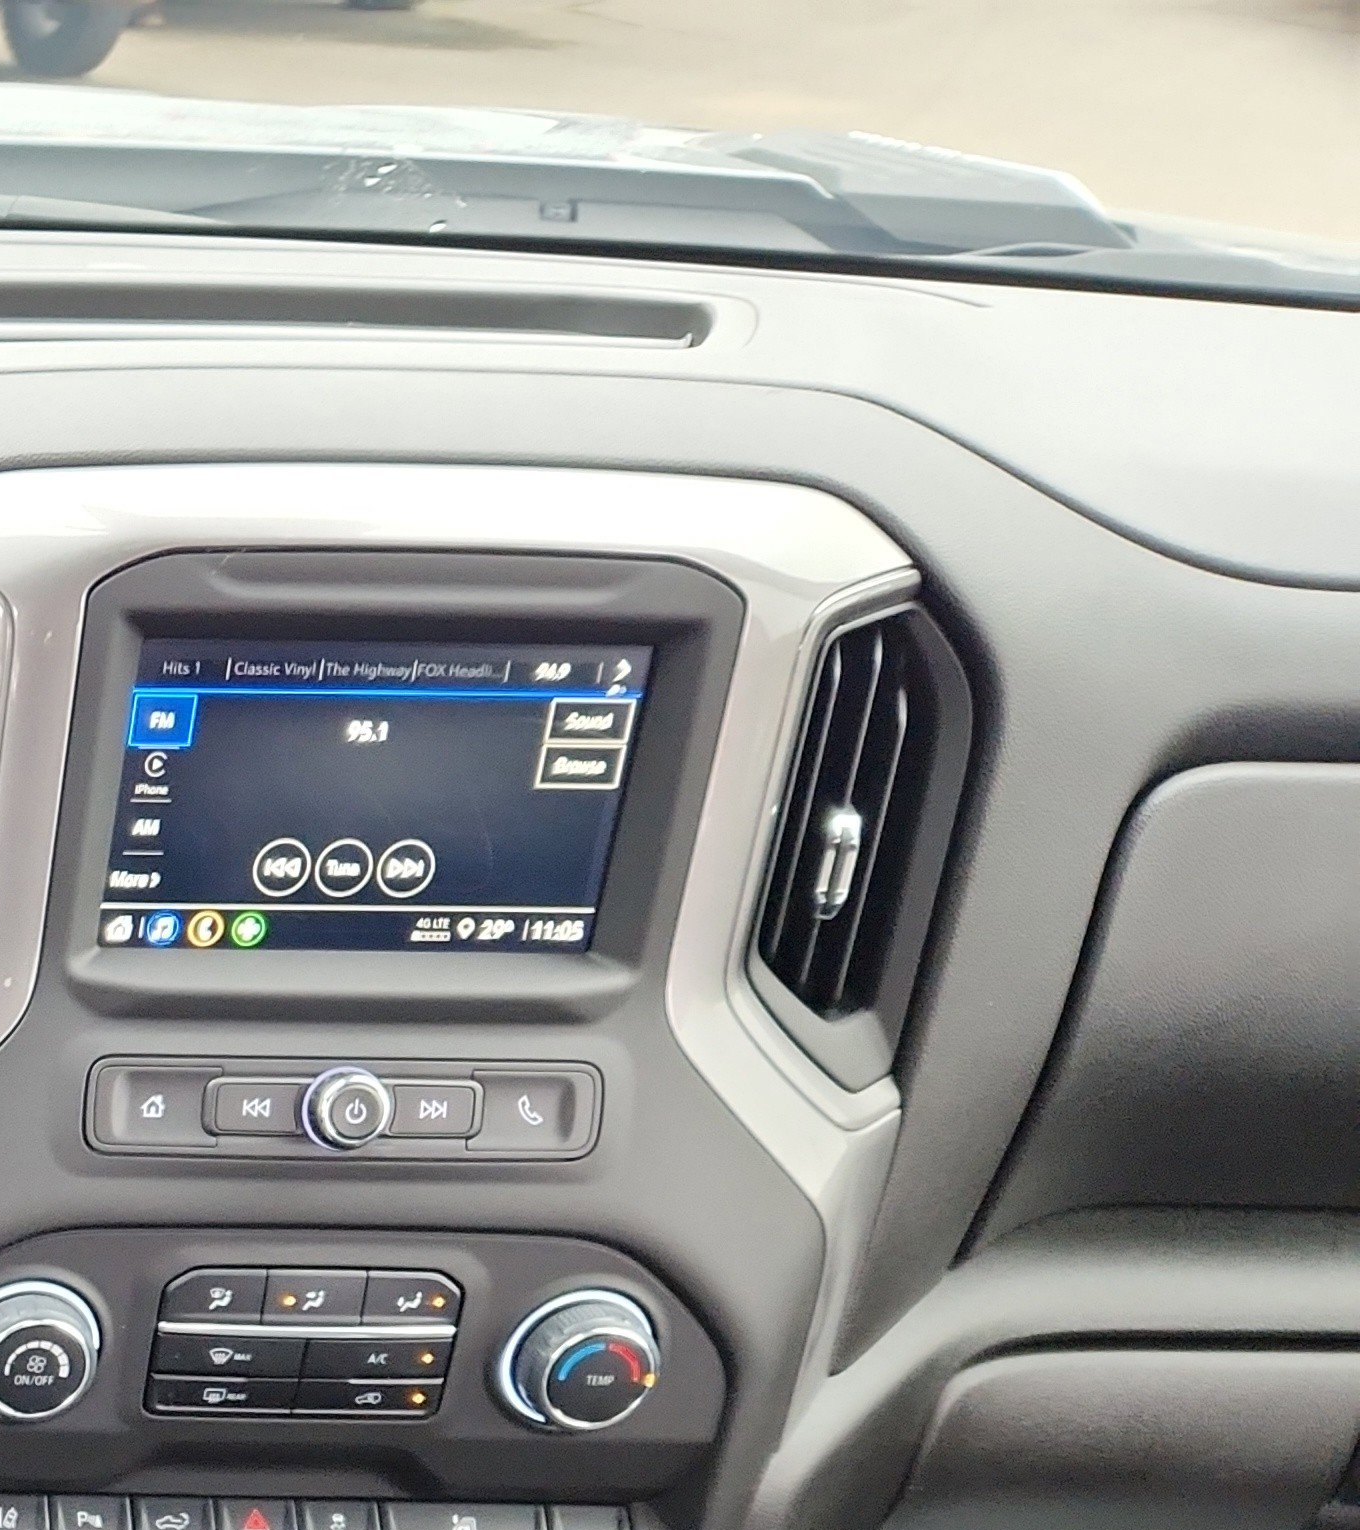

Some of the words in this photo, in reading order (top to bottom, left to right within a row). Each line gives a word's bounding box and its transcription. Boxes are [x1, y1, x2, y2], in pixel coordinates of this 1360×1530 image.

[163, 660, 191, 675] Hits
[233, 661, 281, 677] Classic
[284, 660, 317, 680] Vinyl
[327, 662, 351, 677] The
[353, 662, 412, 681] Highway
[417, 662, 447, 677] FOX
[149, 711, 176, 730] FM
[346, 719, 389, 743] 95.1
[134, 784, 170, 797] iPhone
[131, 818, 161, 837] AM
[109, 870, 150, 889] More
[432, 917, 451, 929] LTE
[530, 919, 585, 942] 11:05
[367, 1353, 389, 1365] A/C
[14, 1374, 55, 1387] ON/OFF
[585, 1374, 615, 1387] TEMP
